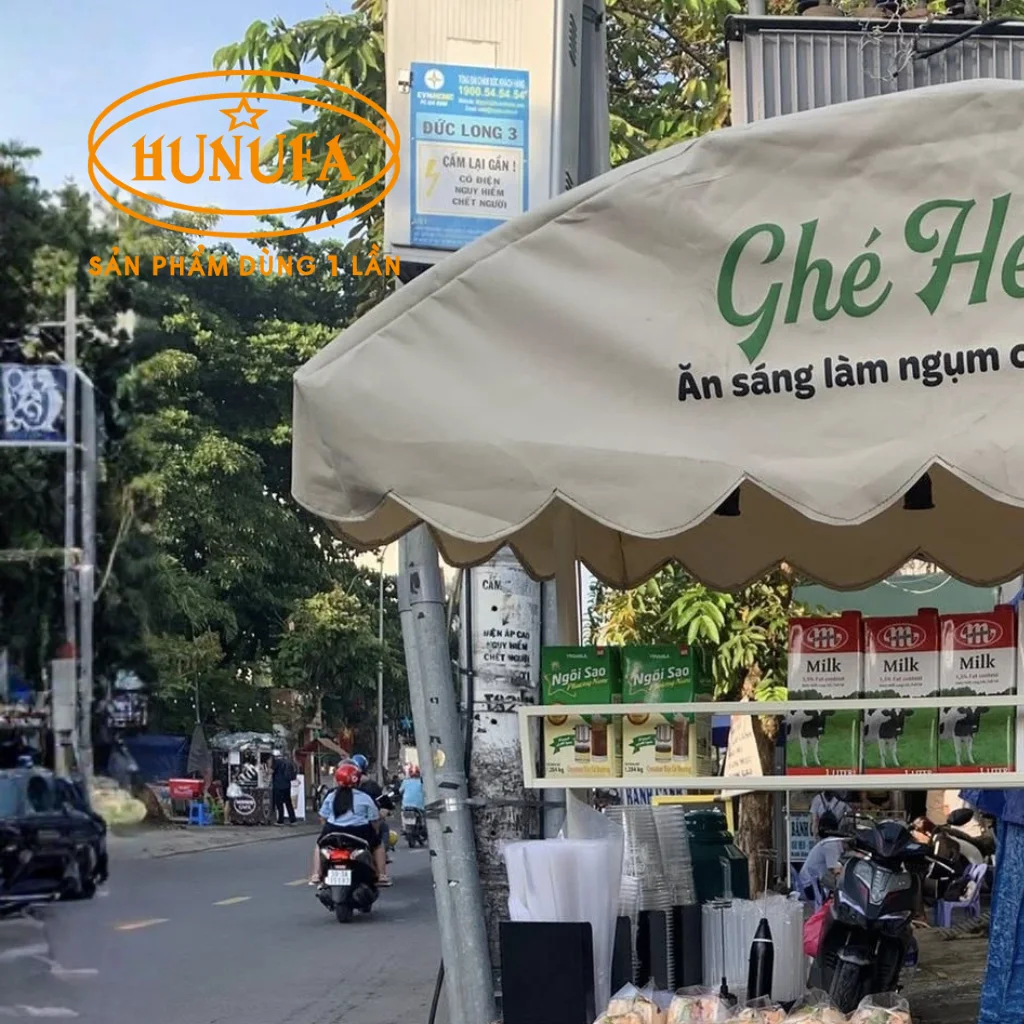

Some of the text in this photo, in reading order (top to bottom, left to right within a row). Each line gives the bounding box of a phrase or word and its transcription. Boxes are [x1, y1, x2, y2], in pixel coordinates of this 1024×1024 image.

[423, 118, 518, 140] ĐỨC LONG 3
[442, 151, 466, 169] CẤM
[468, 158, 486, 172] LẠI
[488, 155, 509, 171] GẦN
[459, 173, 501, 186] CÓ ĐIỆN
[454, 186, 478, 196] NGUY
[452, 197, 477, 207] CHẾT
[717, 218, 893, 364] Ghé
[677, 363, 724, 402] Ăn
[731, 363, 815, 399] sáng
[824, 355, 889, 389] làm
[899, 345, 1000, 387] ngụm
[806, 658, 842, 672] Milk
[883, 657, 919, 672] Milk
[959, 654, 996, 670] Milk
[552, 666, 606, 687] Ngôi Sao
[633, 666, 690, 686] Ngôi Sao
